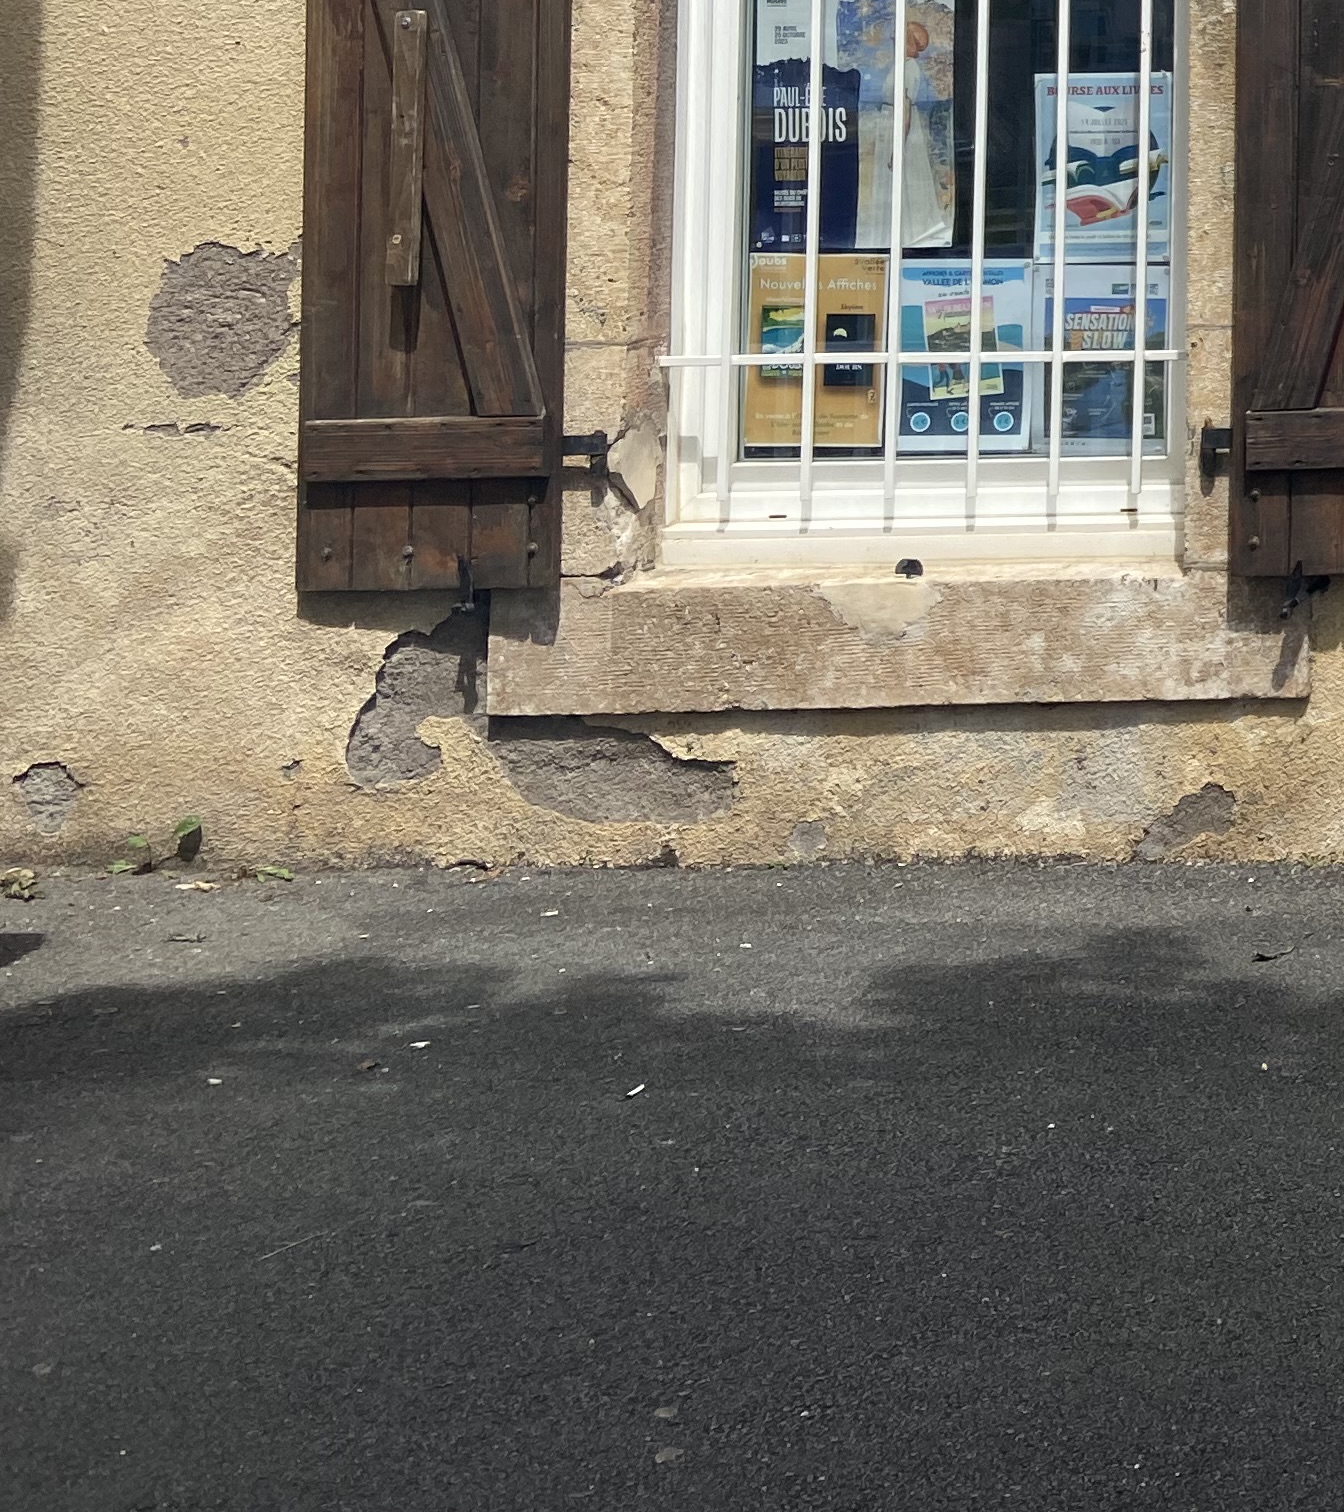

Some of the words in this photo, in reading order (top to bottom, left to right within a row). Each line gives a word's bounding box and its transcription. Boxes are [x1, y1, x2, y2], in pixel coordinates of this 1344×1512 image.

[1047, 86, 1094, 96] BRSE
[1095, 86, 1120, 95] AUX
[1121, 85, 1164, 95] LIVES
[774, 107, 847, 142] DUBIS
[827, 278, 877, 291] Affiches
[1082, 330, 1128, 349] SLOW
